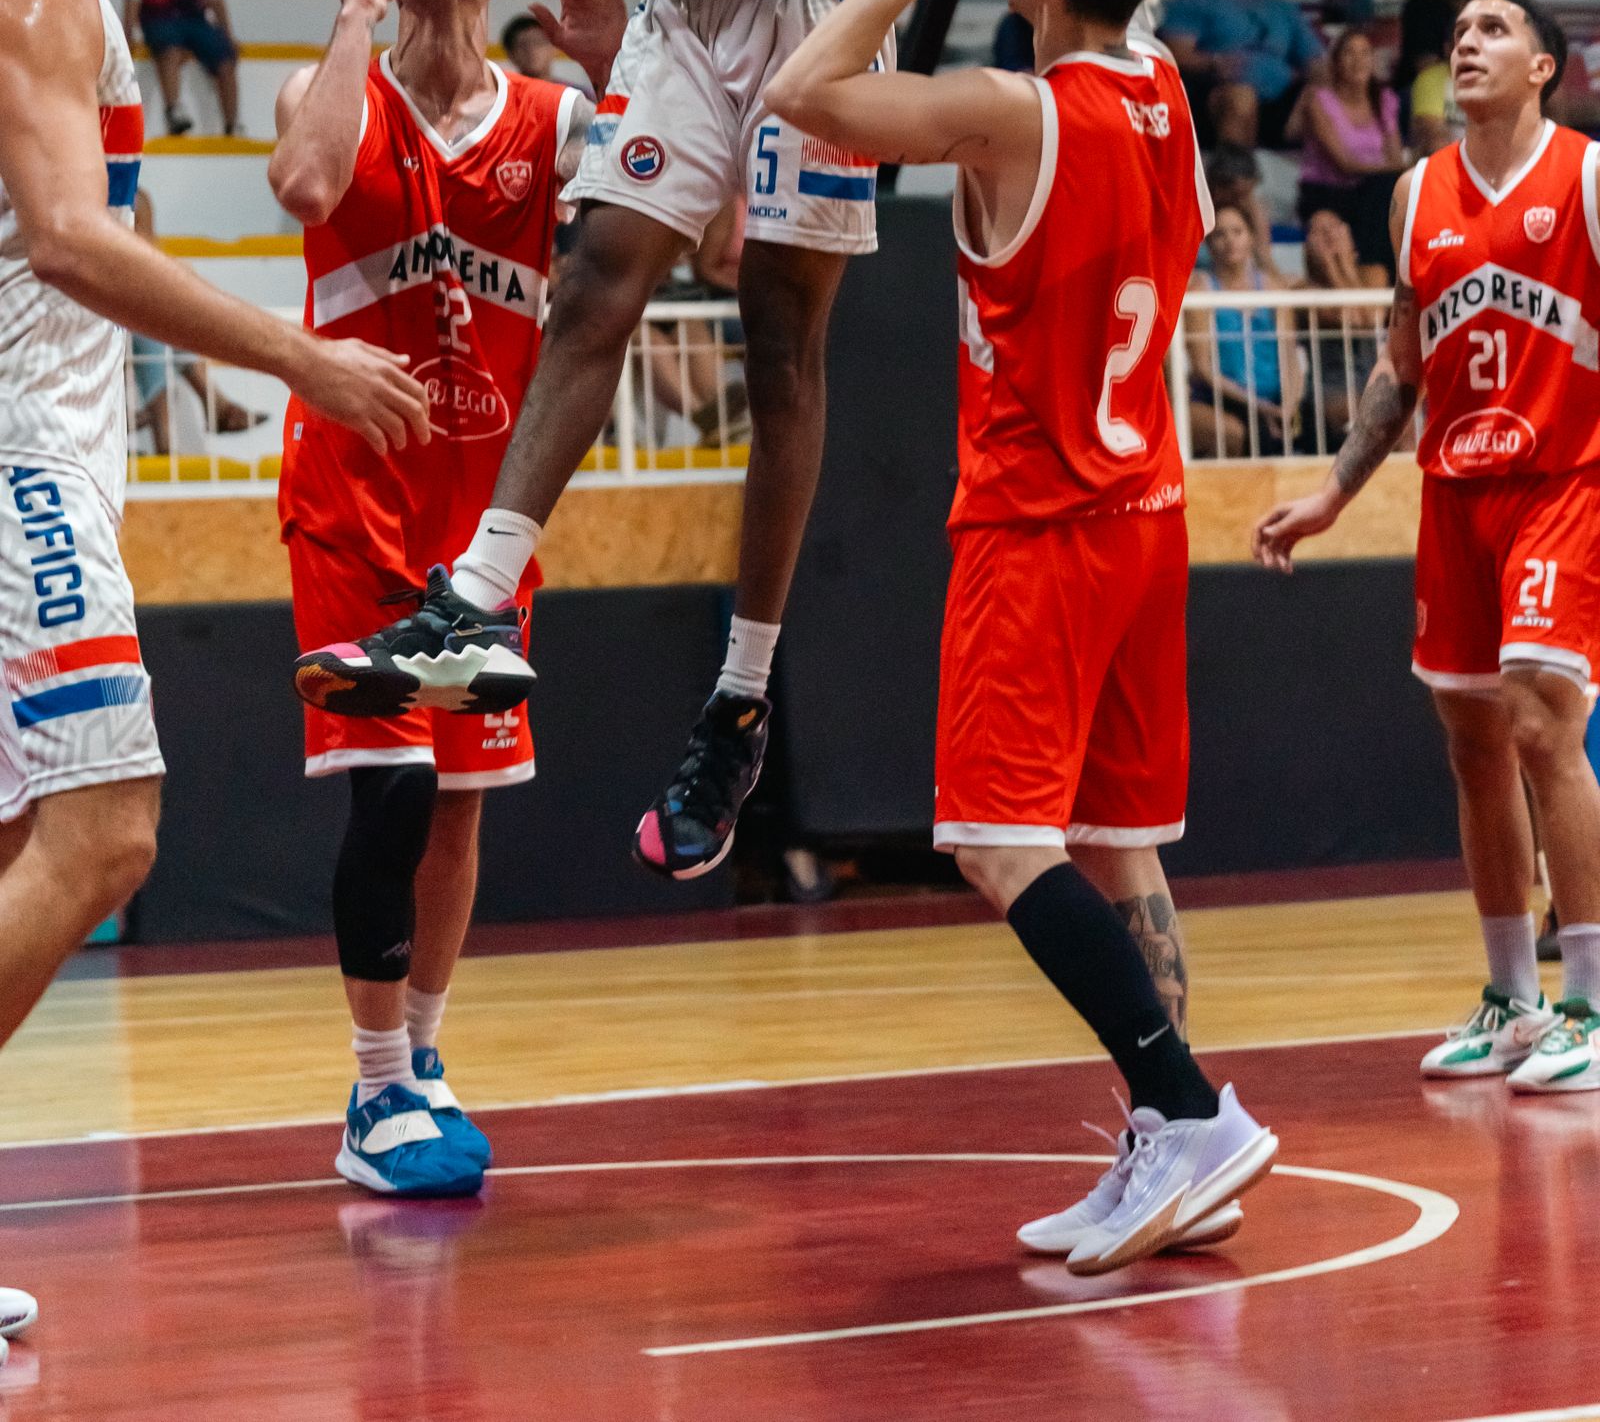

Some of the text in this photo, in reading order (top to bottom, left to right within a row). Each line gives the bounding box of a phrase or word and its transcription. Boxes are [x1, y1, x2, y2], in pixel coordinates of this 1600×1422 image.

[756, 126, 780, 195] 5
[1097, 276, 1158, 457] 2
[1468, 329, 1508, 391] 21
[1519, 558, 1558, 609] 21
